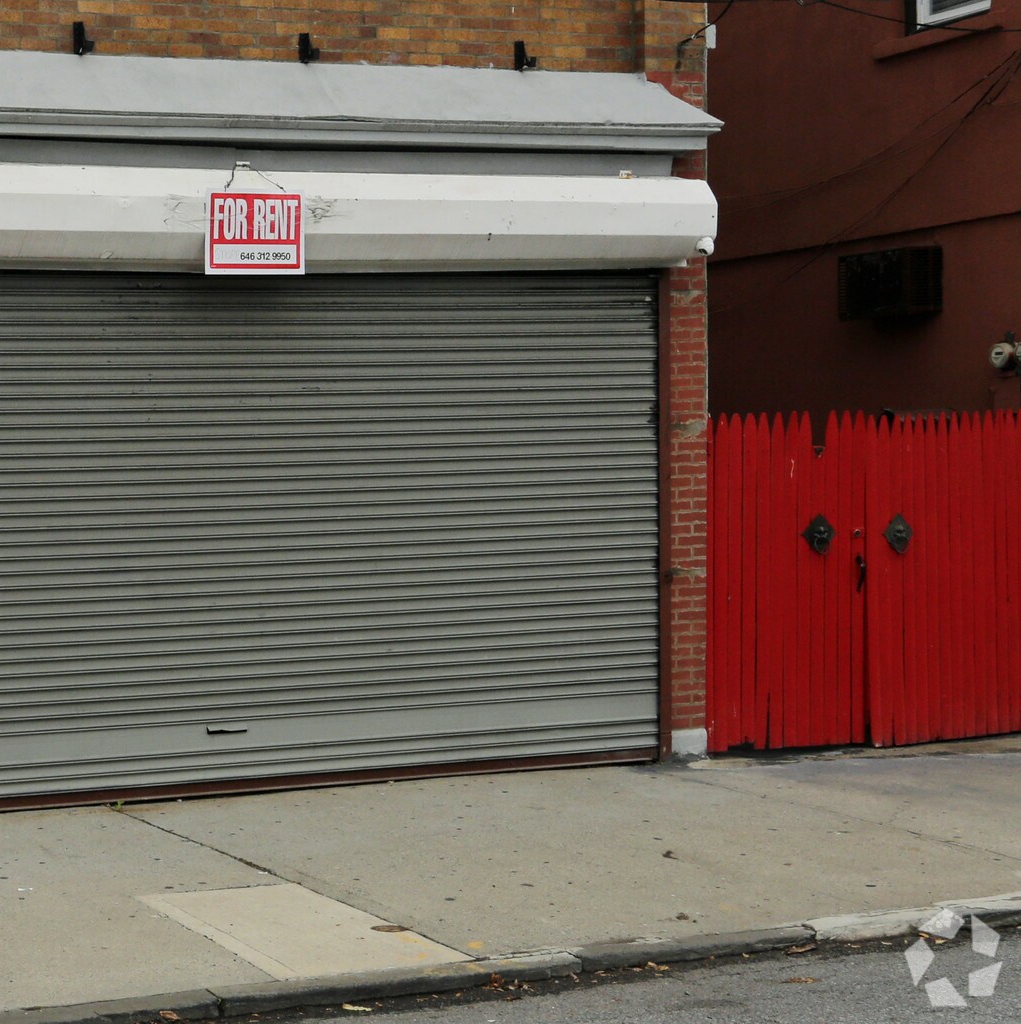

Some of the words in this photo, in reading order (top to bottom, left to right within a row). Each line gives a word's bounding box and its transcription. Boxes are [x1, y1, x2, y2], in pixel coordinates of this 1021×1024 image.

[213, 197, 248, 240] FOR
[253, 198, 299, 240] RENT
[240, 252, 255, 260] 646
[256, 252, 271, 260] 312
[272, 252, 291, 260] 9950
